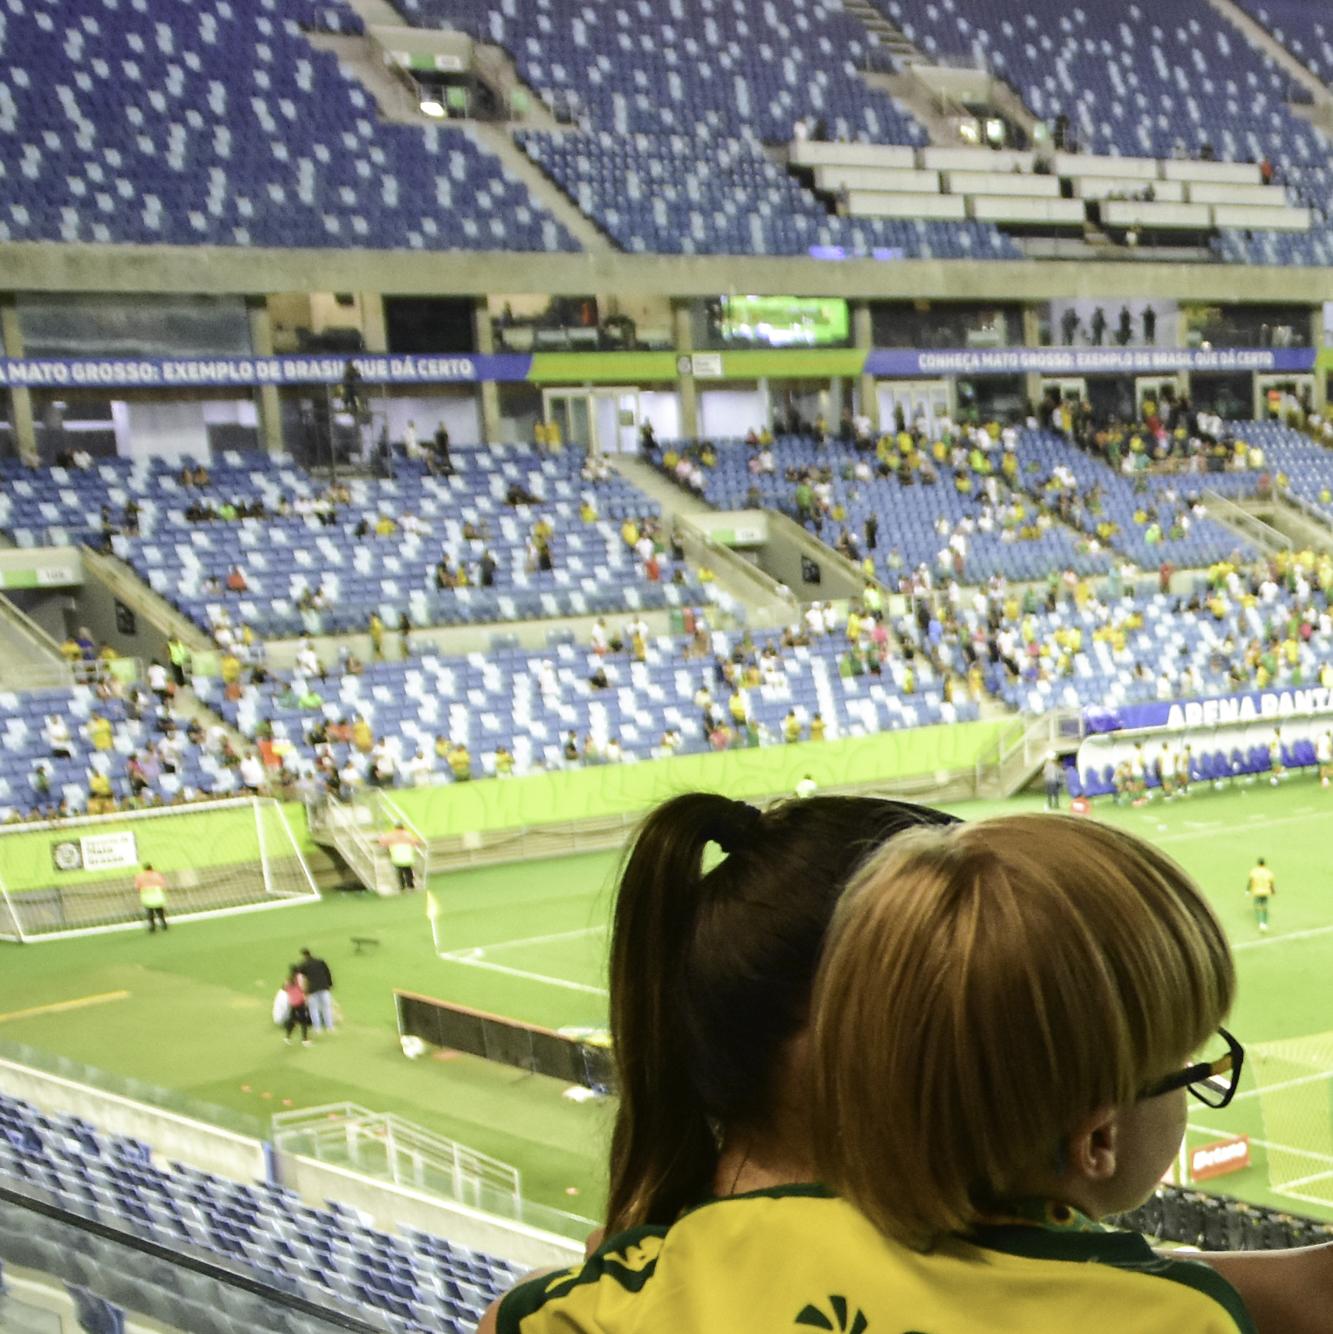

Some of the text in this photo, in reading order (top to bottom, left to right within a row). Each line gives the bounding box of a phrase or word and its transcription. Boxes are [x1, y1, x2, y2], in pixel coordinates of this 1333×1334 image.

[7, 361, 68, 383] MATO
[71, 361, 160, 383] GROSSO:
[162, 360, 255, 382] EXEMPLO
[255, 360, 282, 381] DE
[416, 357, 475, 380] CERTO
[1167, 693, 1257, 730] ARENA
